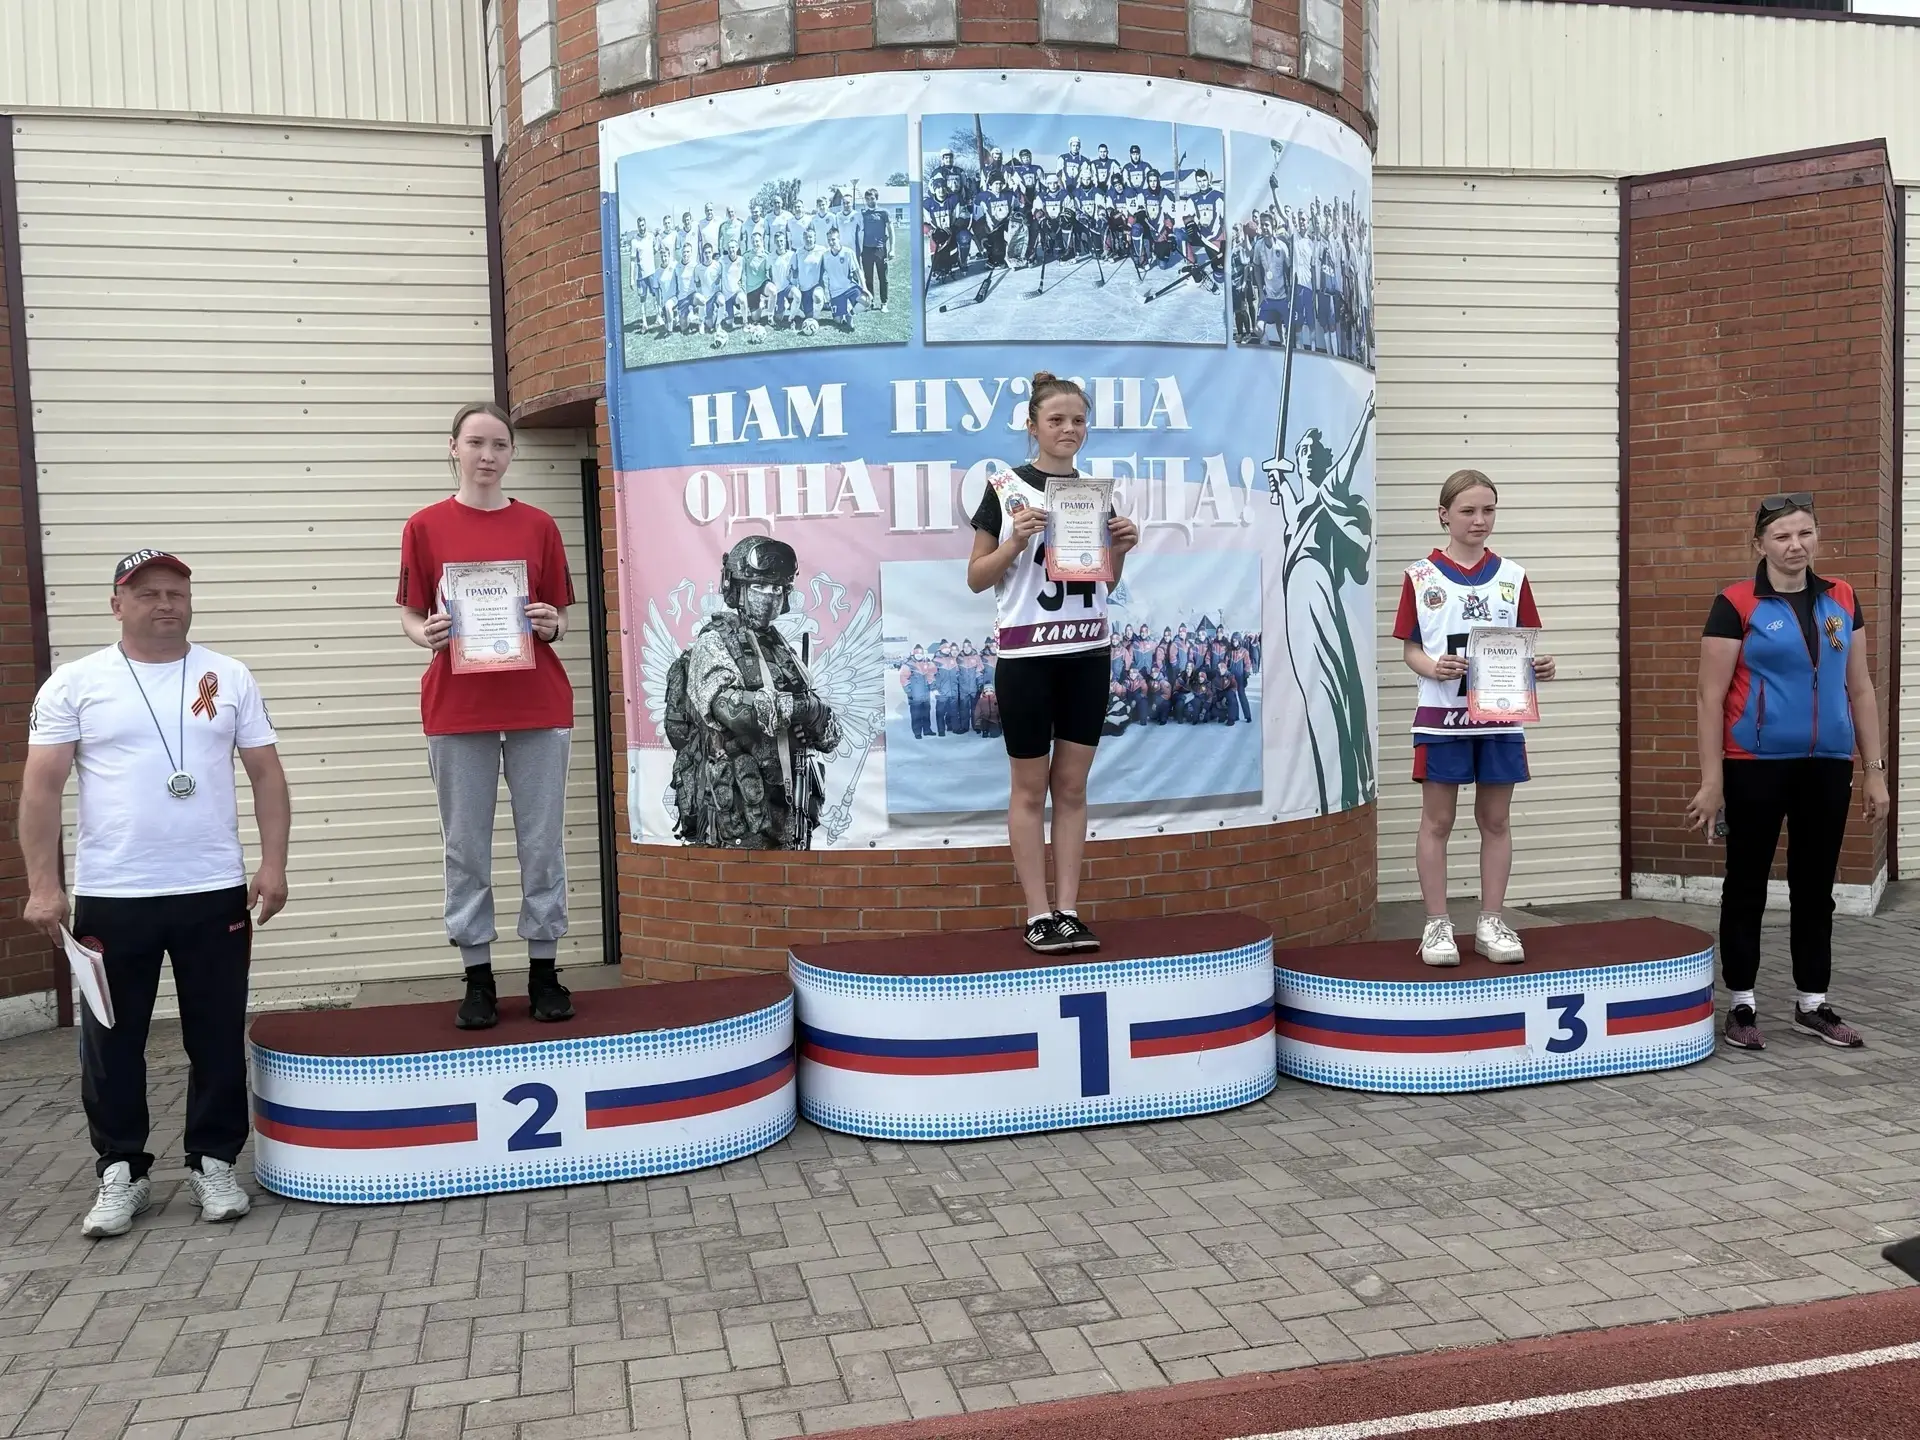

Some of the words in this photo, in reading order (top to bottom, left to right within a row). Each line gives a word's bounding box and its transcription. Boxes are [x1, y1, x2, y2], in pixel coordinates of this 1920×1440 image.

[688, 383, 848, 447] НАМ
[685, 457, 885, 535] ОДНА
[887, 451, 1255, 547] ПОЕДА!
[1060, 502, 1095, 510] ГРАМОТА
[465, 587, 508, 597] ГРАМОТА
[1031, 622, 1102, 643] КЛЮЧИ
[1483, 647, 1518, 656] ГРАМОТА
[1059, 991, 1110, 1098] 1
[1545, 993, 1588, 1054] 3
[502, 1082, 562, 1152] 2
